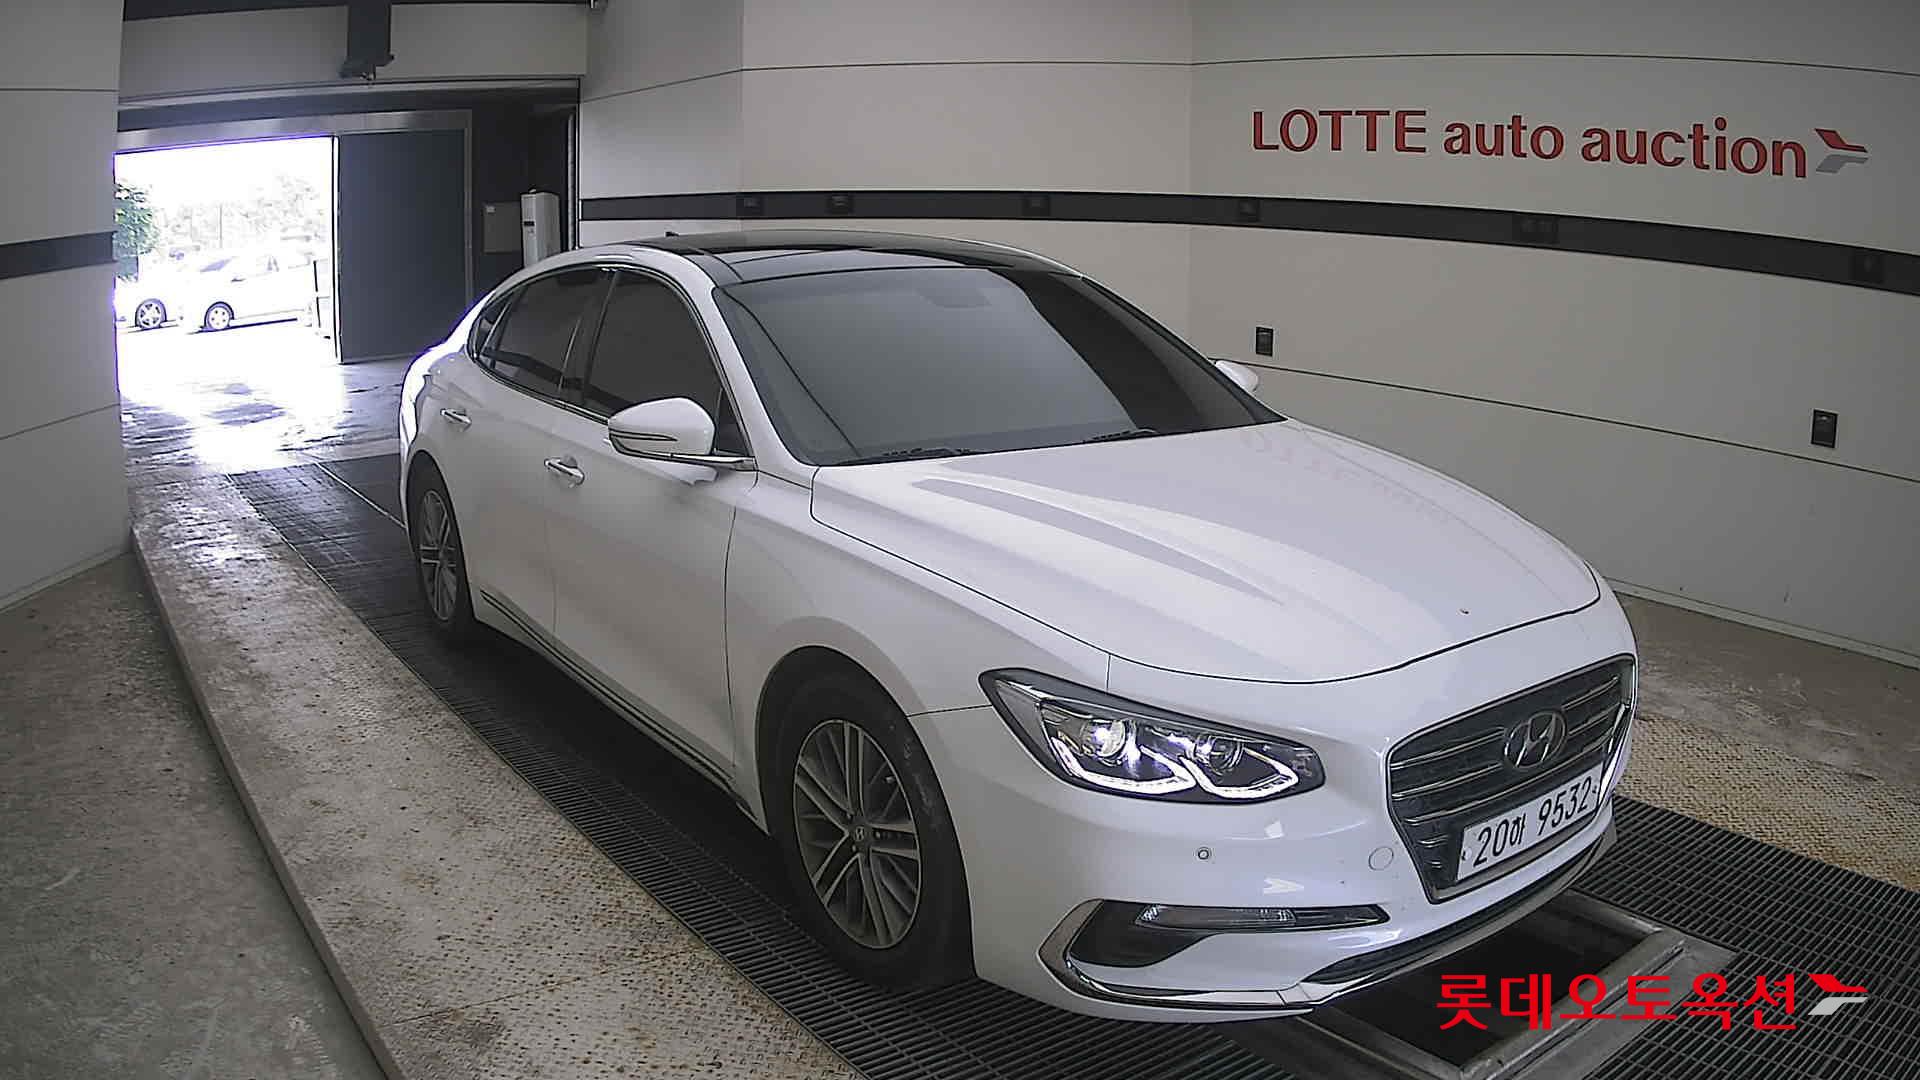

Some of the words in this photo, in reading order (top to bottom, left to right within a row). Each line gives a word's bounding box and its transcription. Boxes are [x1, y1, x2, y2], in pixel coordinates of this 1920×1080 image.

[1251, 108, 1428, 154] LOTTE
[1443, 114, 1565, 161] auto
[1581, 116, 1808, 178] auction
[1473, 812, 1526, 867] 20하
[1538, 776, 1591, 836] 9532
